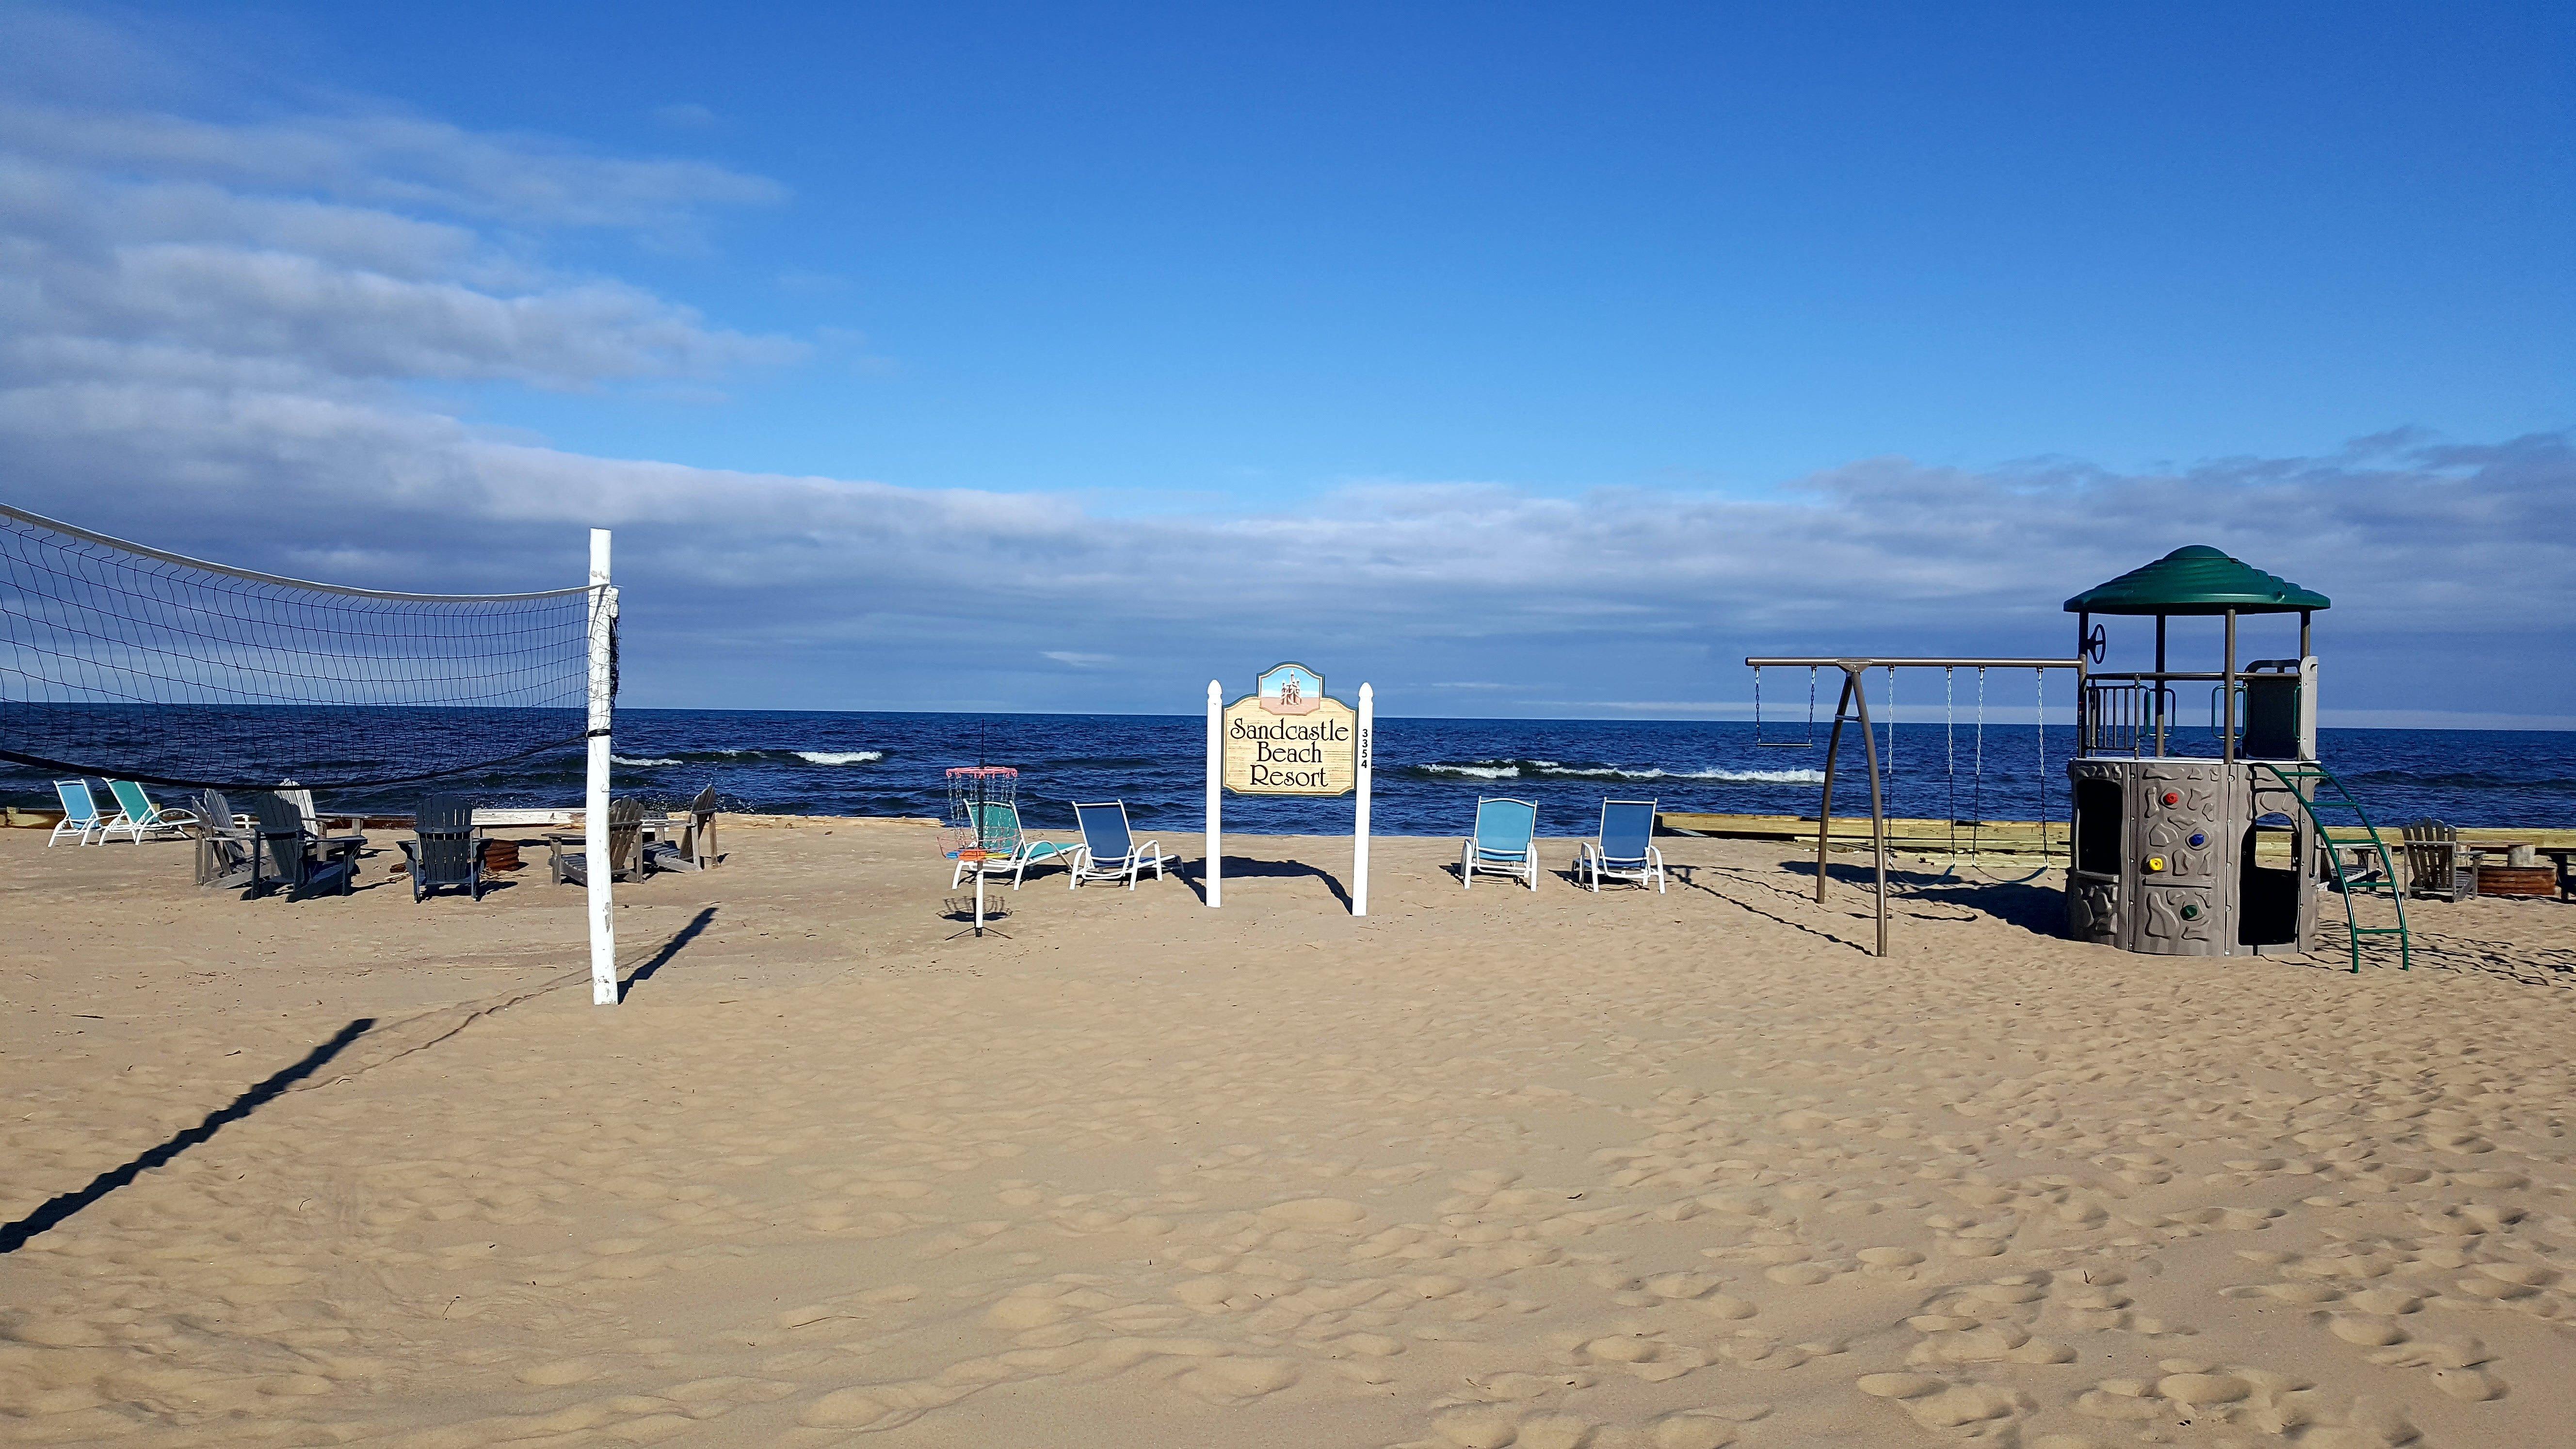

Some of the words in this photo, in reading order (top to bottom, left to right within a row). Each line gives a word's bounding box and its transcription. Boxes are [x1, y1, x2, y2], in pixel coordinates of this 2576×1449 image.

[1230, 718, 1349, 741] Sandcastle
[1256, 741, 1322, 763] Beach
[1250, 764, 1329, 787] Resort
